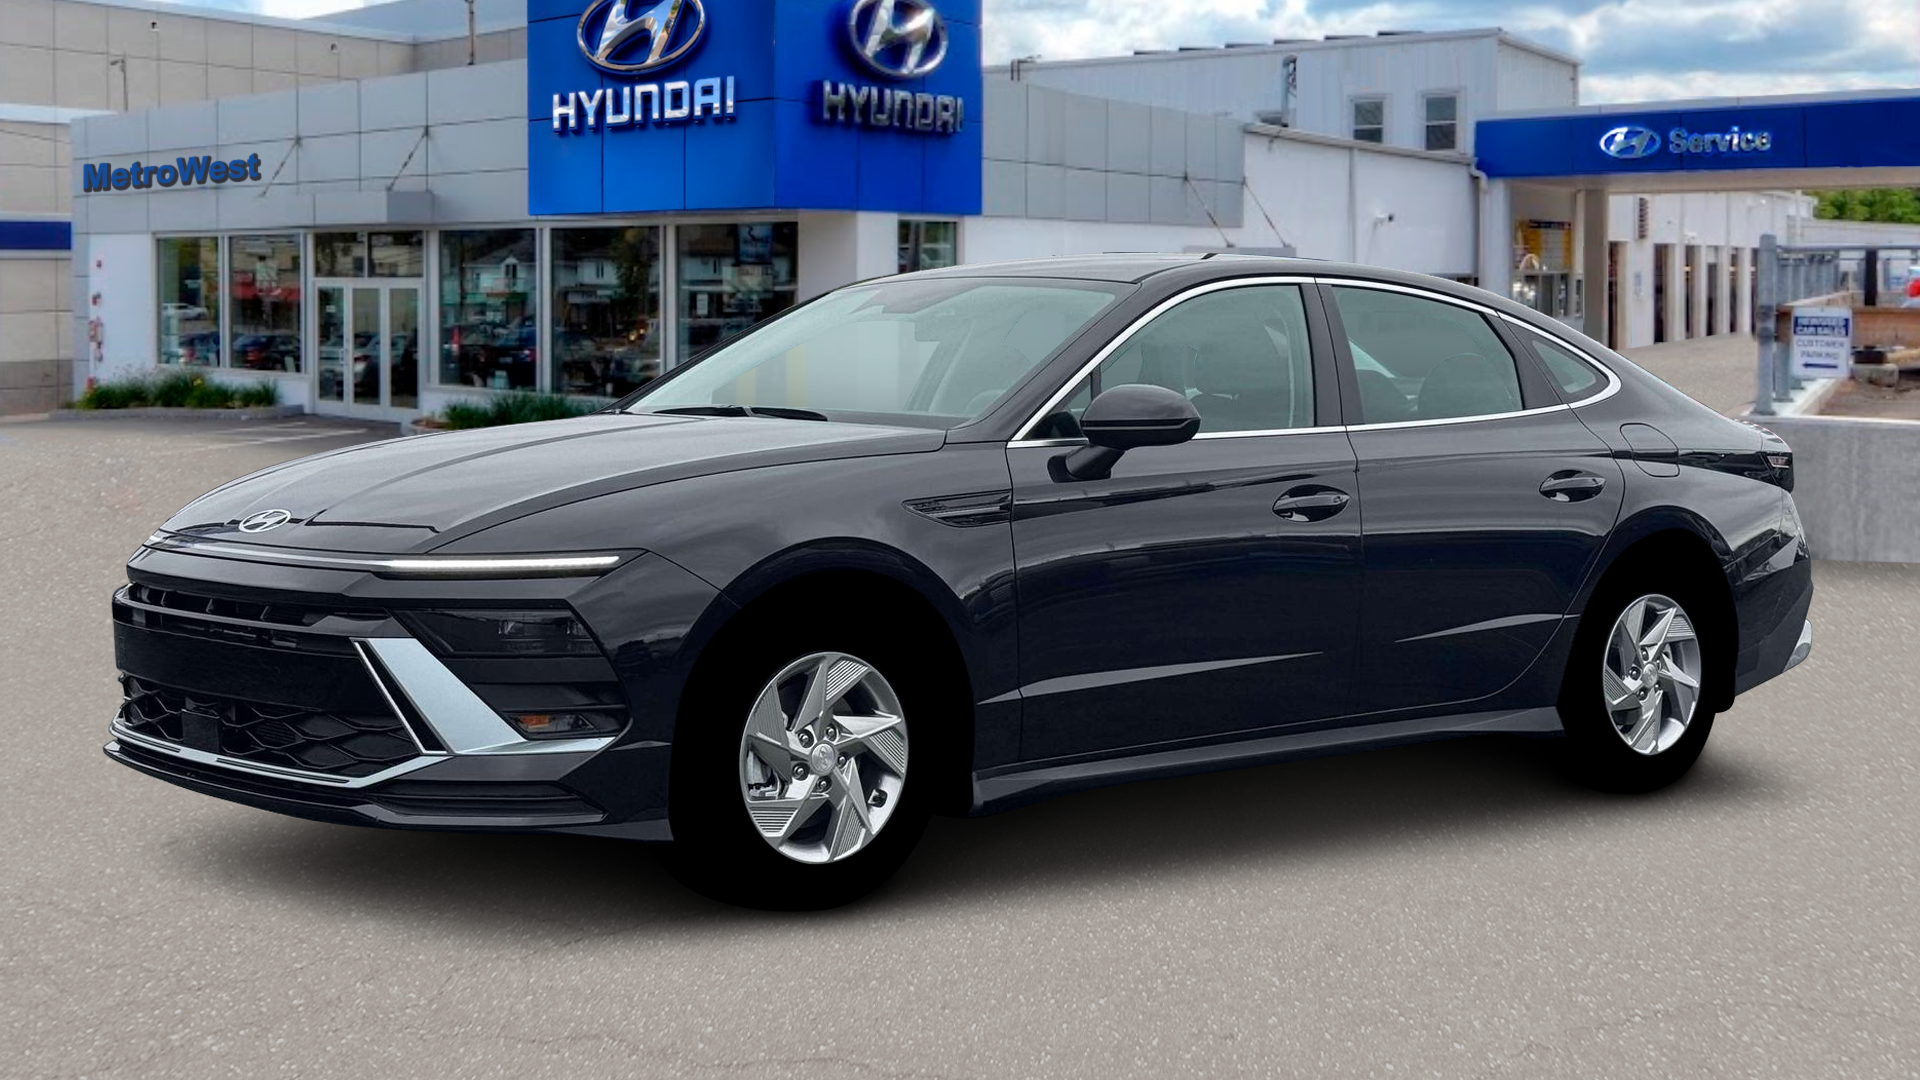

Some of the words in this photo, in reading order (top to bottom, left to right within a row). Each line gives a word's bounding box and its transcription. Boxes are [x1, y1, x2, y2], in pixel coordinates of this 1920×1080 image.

[552, 75, 736, 132] HYUNDAI
[822, 80, 965, 132] HYUNDAI
[1669, 125, 1772, 153] Service
[83, 153, 262, 193] MetroWest
[1796, 339, 1845, 348] CUSTOMER
[1800, 350, 1840, 360] PARKING
